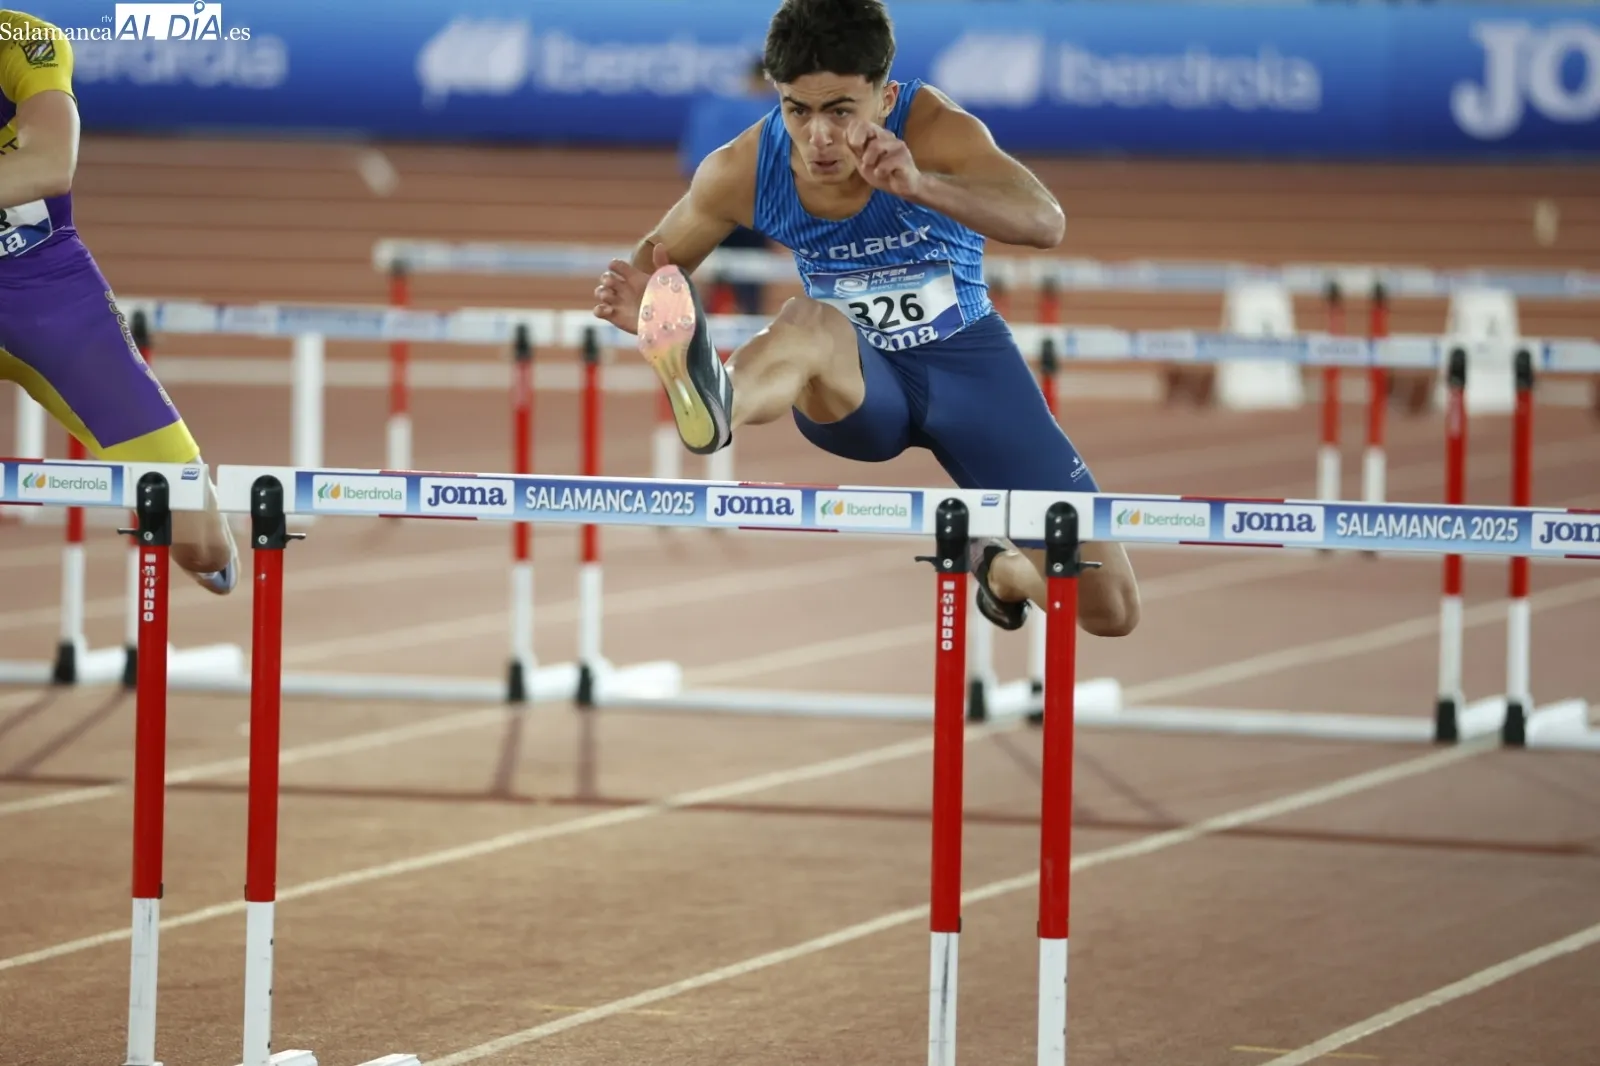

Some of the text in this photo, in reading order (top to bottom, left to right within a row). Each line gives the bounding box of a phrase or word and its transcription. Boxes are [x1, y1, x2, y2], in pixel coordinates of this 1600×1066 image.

[848, 292, 924, 330] 326
[48, 475, 108, 492] Iberdrola
[343, 485, 404, 502] Iberdrola
[524, 485, 696, 516] SALAMANCA 2025
[846, 503, 908, 519] Iberdrola
[1143, 512, 1206, 529] Iberdrola
[1336, 511, 1521, 543] SALAMANCA 2025
